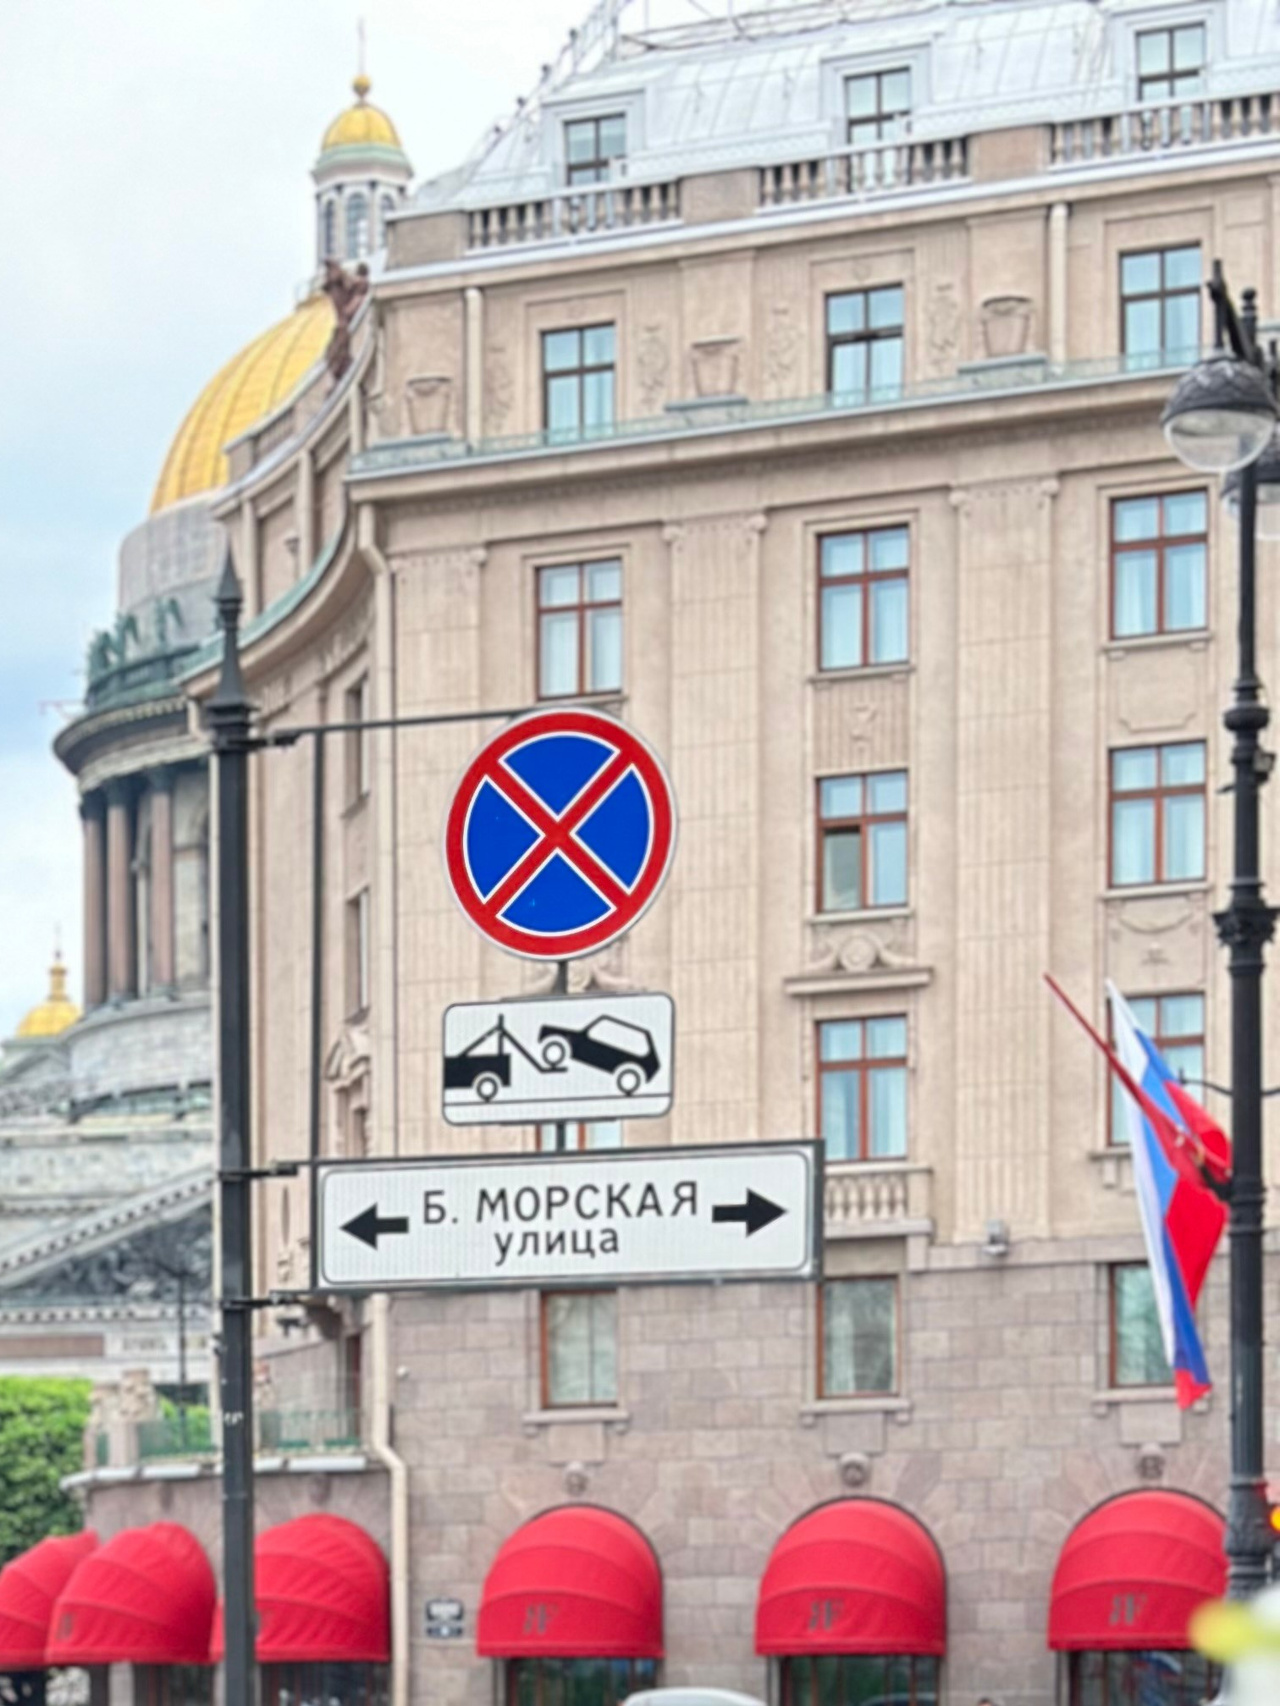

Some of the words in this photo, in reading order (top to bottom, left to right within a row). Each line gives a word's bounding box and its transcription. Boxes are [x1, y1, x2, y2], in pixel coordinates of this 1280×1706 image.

[422, 1189, 459, 1225] Б.
[475, 1180, 698, 1223] МОРСКАЯ
[493, 1227, 620, 1267] улица
